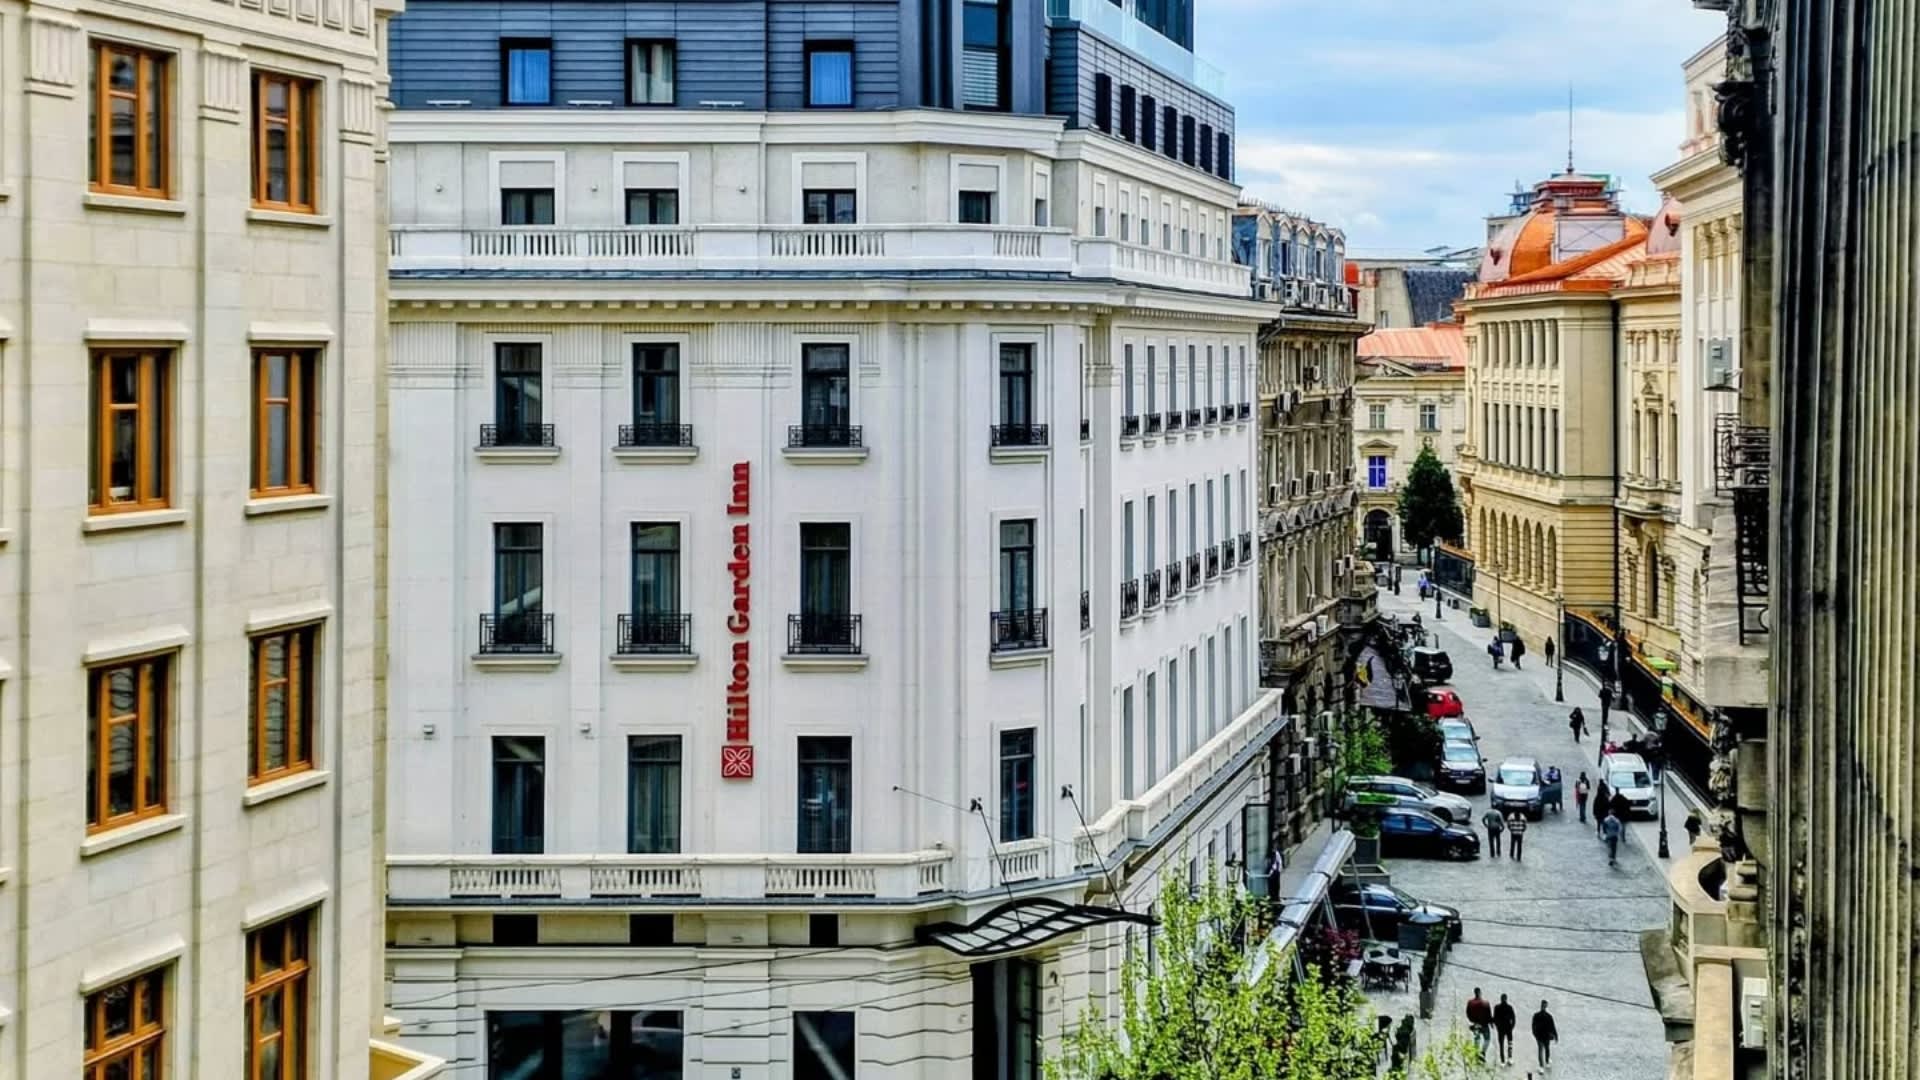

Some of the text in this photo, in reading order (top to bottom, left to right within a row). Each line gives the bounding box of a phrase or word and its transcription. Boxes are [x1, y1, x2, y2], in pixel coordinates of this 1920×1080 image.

[727, 461, 750, 742] Hilton Garden Inn
